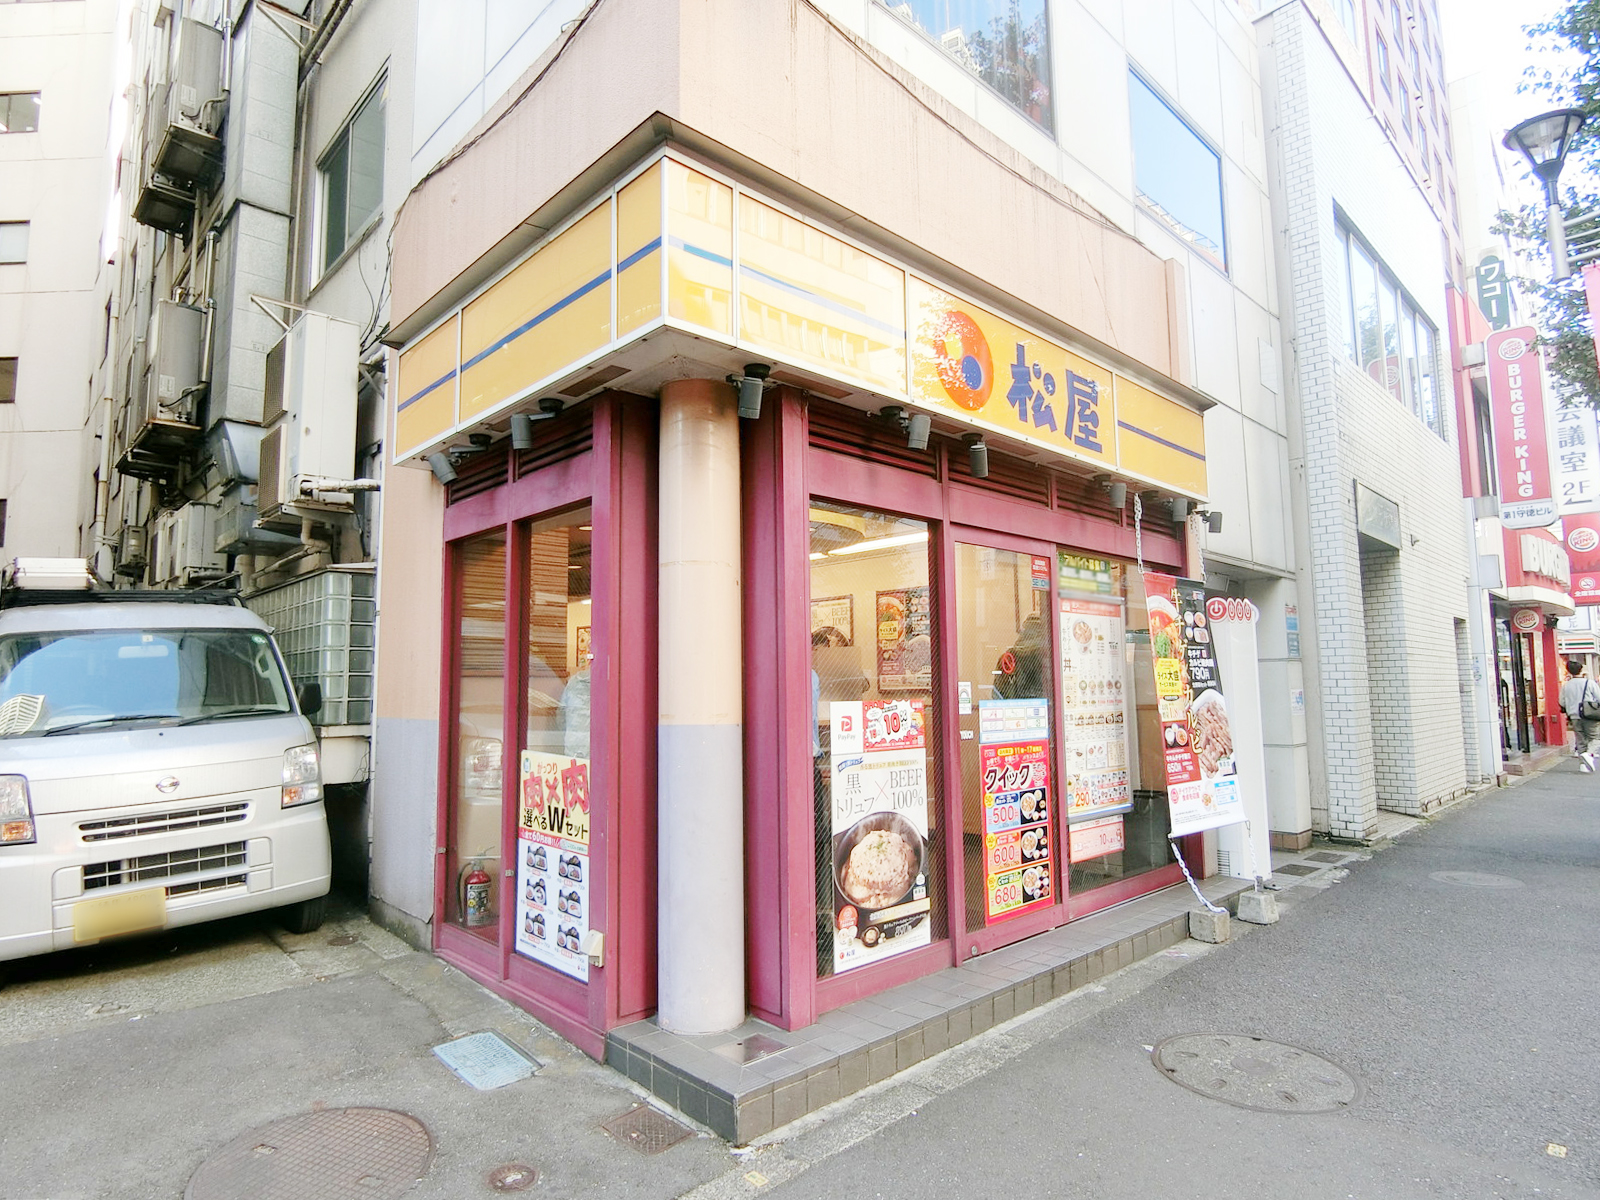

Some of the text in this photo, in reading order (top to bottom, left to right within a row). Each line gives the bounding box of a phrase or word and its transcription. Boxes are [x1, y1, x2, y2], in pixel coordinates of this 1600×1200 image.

[1481, 262, 1508, 331] ワコー
[1006, 343, 1102, 453] 松屋
[1508, 364, 1533, 497] BURGER KING
[1563, 481, 1590, 496] 2F
[1518, 615, 1536, 625] KING
[838, 733, 856, 741] PayPay
[537, 762, 558, 775] がっつり
[890, 768, 923, 789] BEEF
[985, 764, 1030, 792] クイック
[845, 773, 862, 796] 黒
[836, 797, 875, 820] トリュフ
[892, 788, 924, 811] 100%
[1075, 791, 1090, 807] 290
